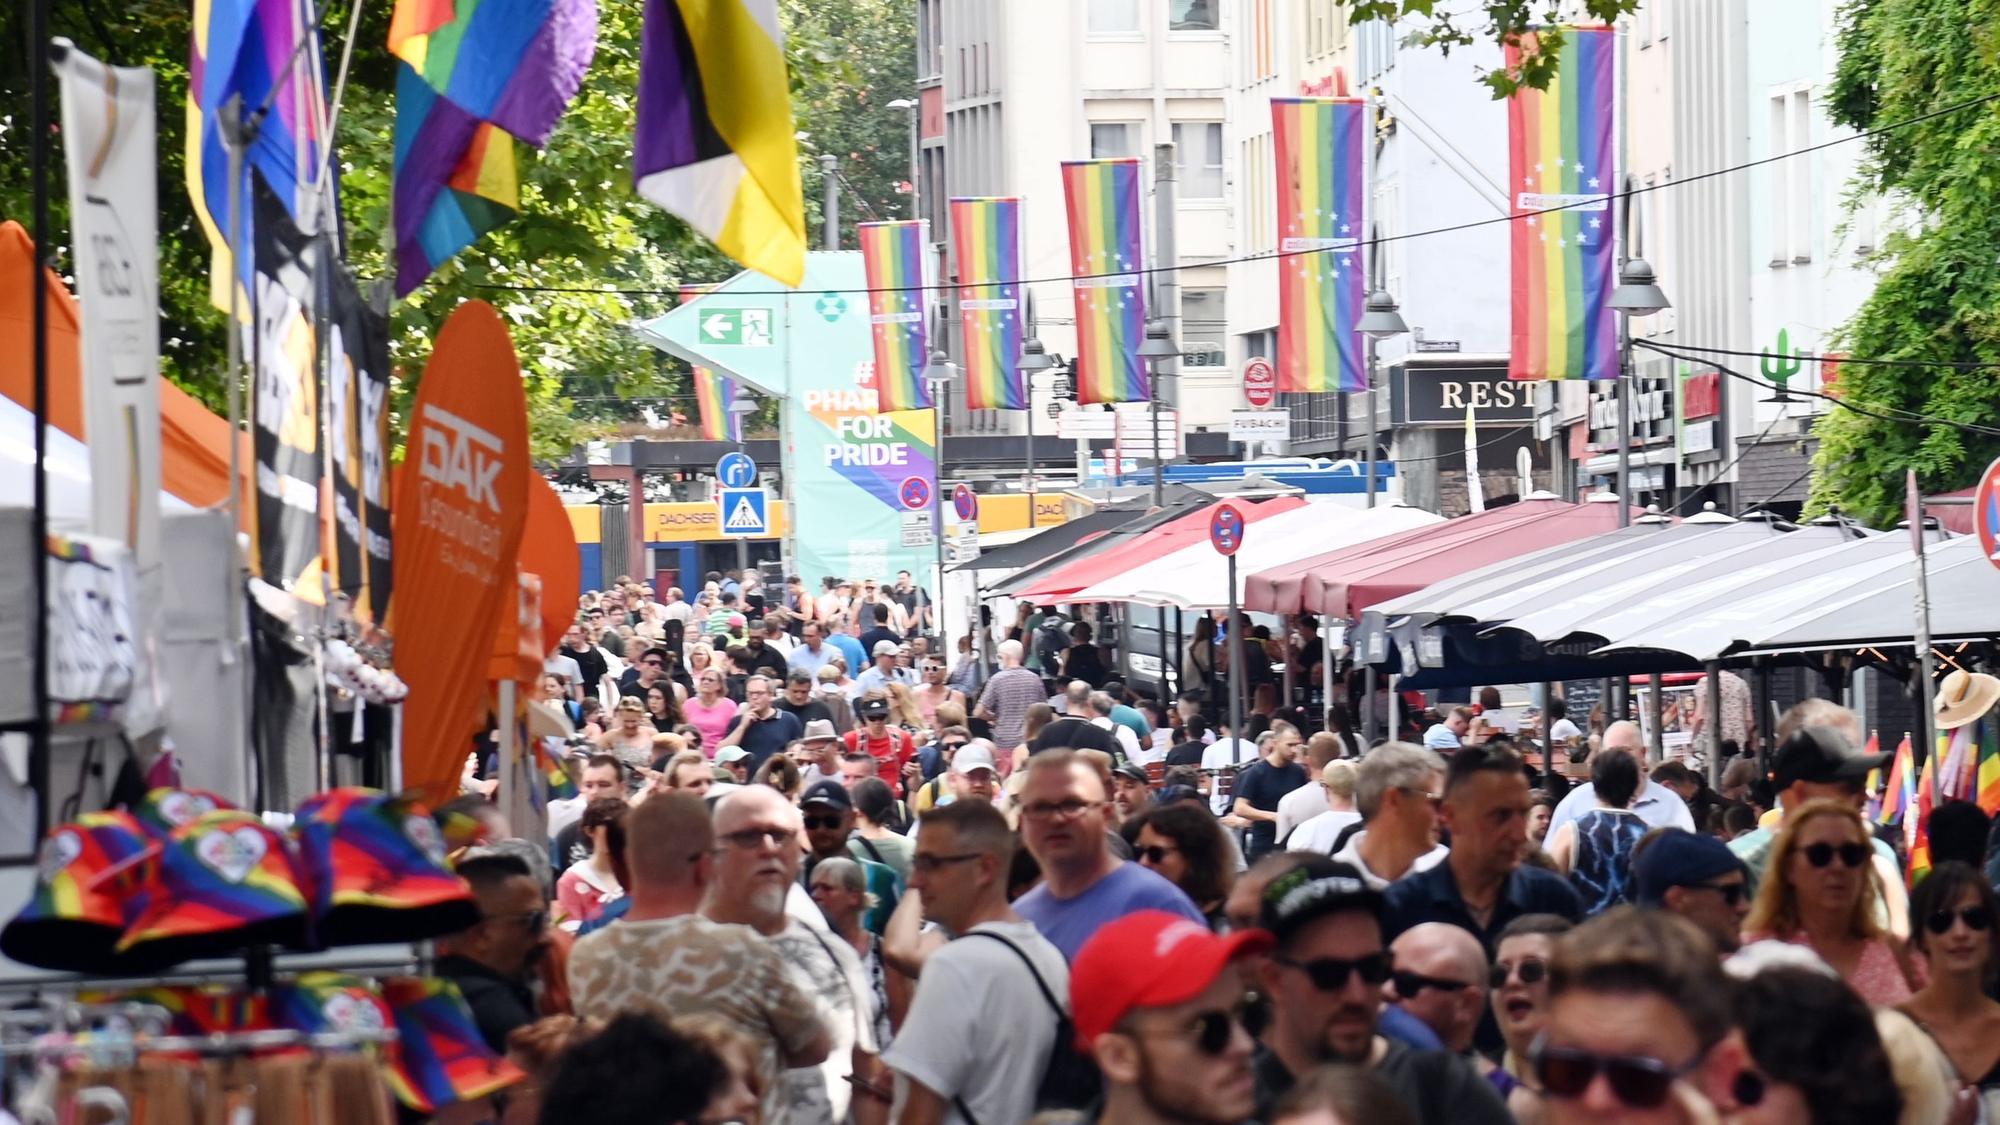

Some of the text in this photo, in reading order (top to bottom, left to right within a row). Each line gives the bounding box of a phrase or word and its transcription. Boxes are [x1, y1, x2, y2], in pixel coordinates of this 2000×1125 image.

[803, 388, 879, 412] PHAR
[1439, 380, 1538, 409] REST
[836, 415, 894, 439] FOR
[419, 402, 504, 514] DAK
[823, 442, 909, 466] PRIDE
[659, 512, 717, 525] DACHSER
[1036, 504, 1063, 515] DAC
